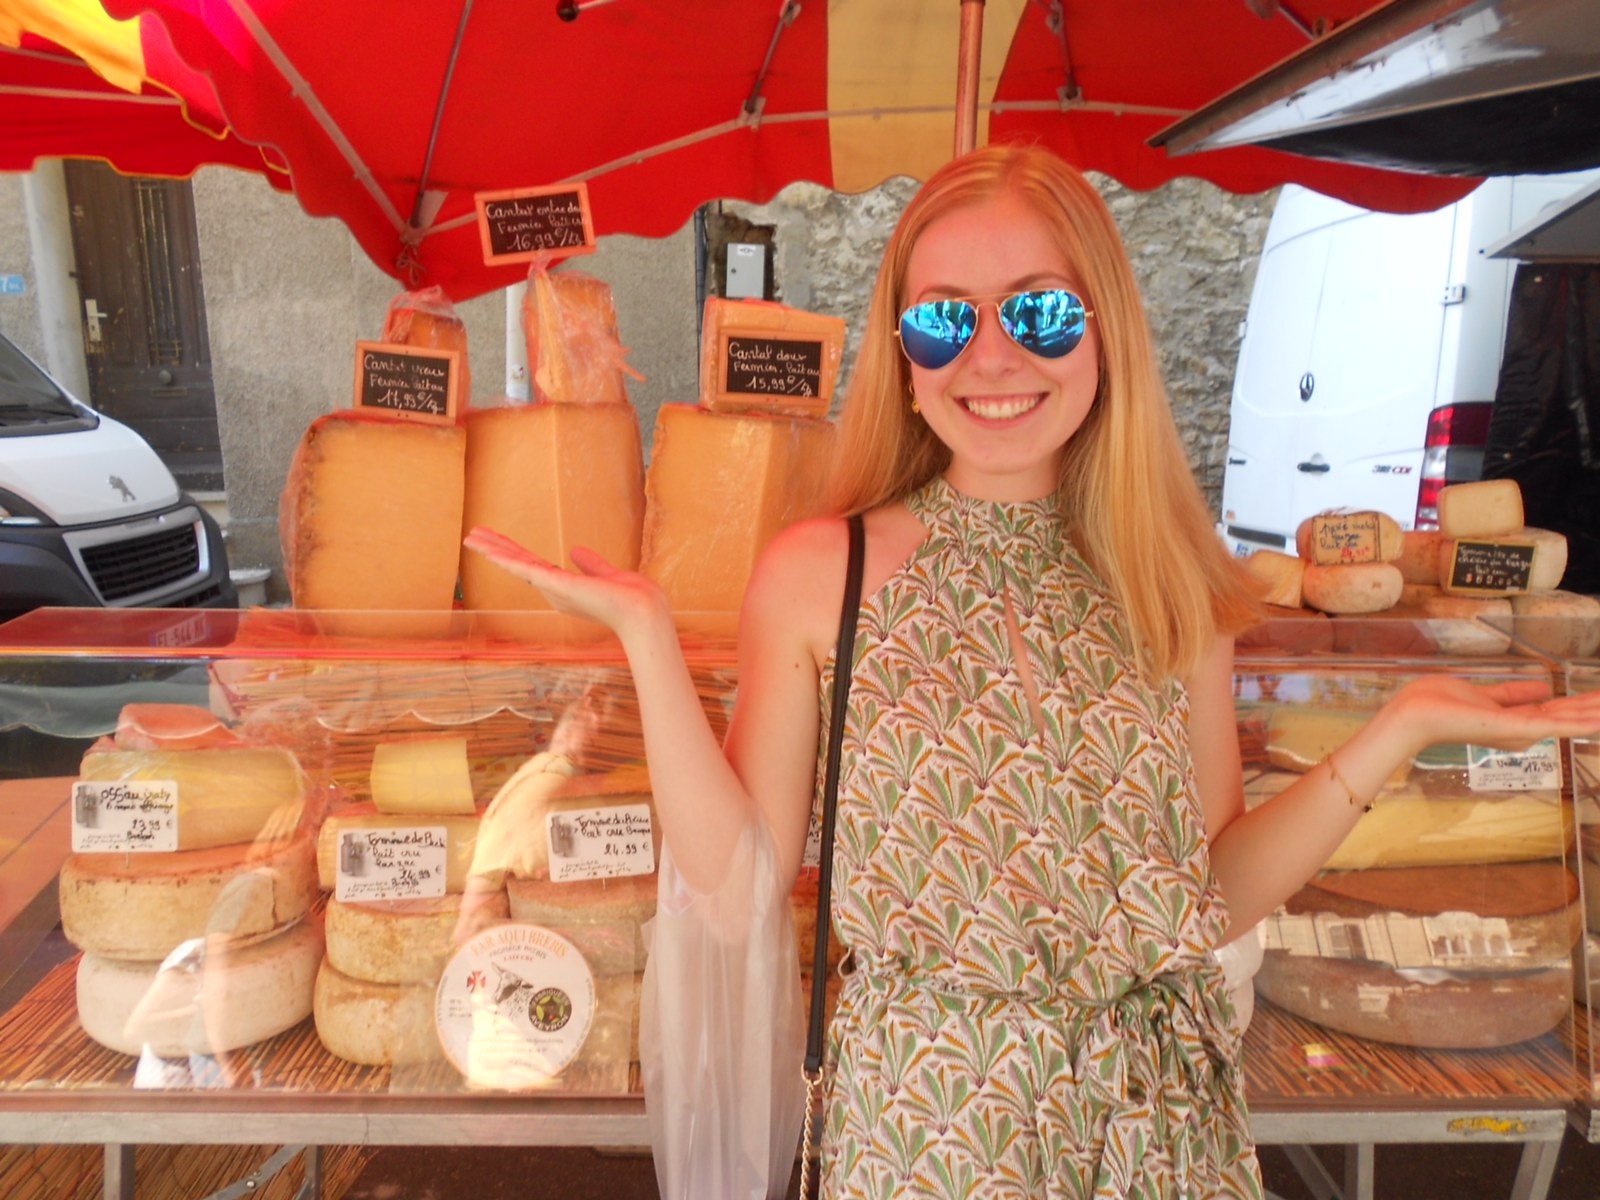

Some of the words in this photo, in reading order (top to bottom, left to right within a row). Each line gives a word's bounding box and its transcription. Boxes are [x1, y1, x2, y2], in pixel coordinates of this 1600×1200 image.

[729, 342, 772, 360] Cantal
[776, 349, 807, 361] doux
[1392, 465, 1412, 475] CDI
[530, 1014, 569, 1032] AVEYRON
